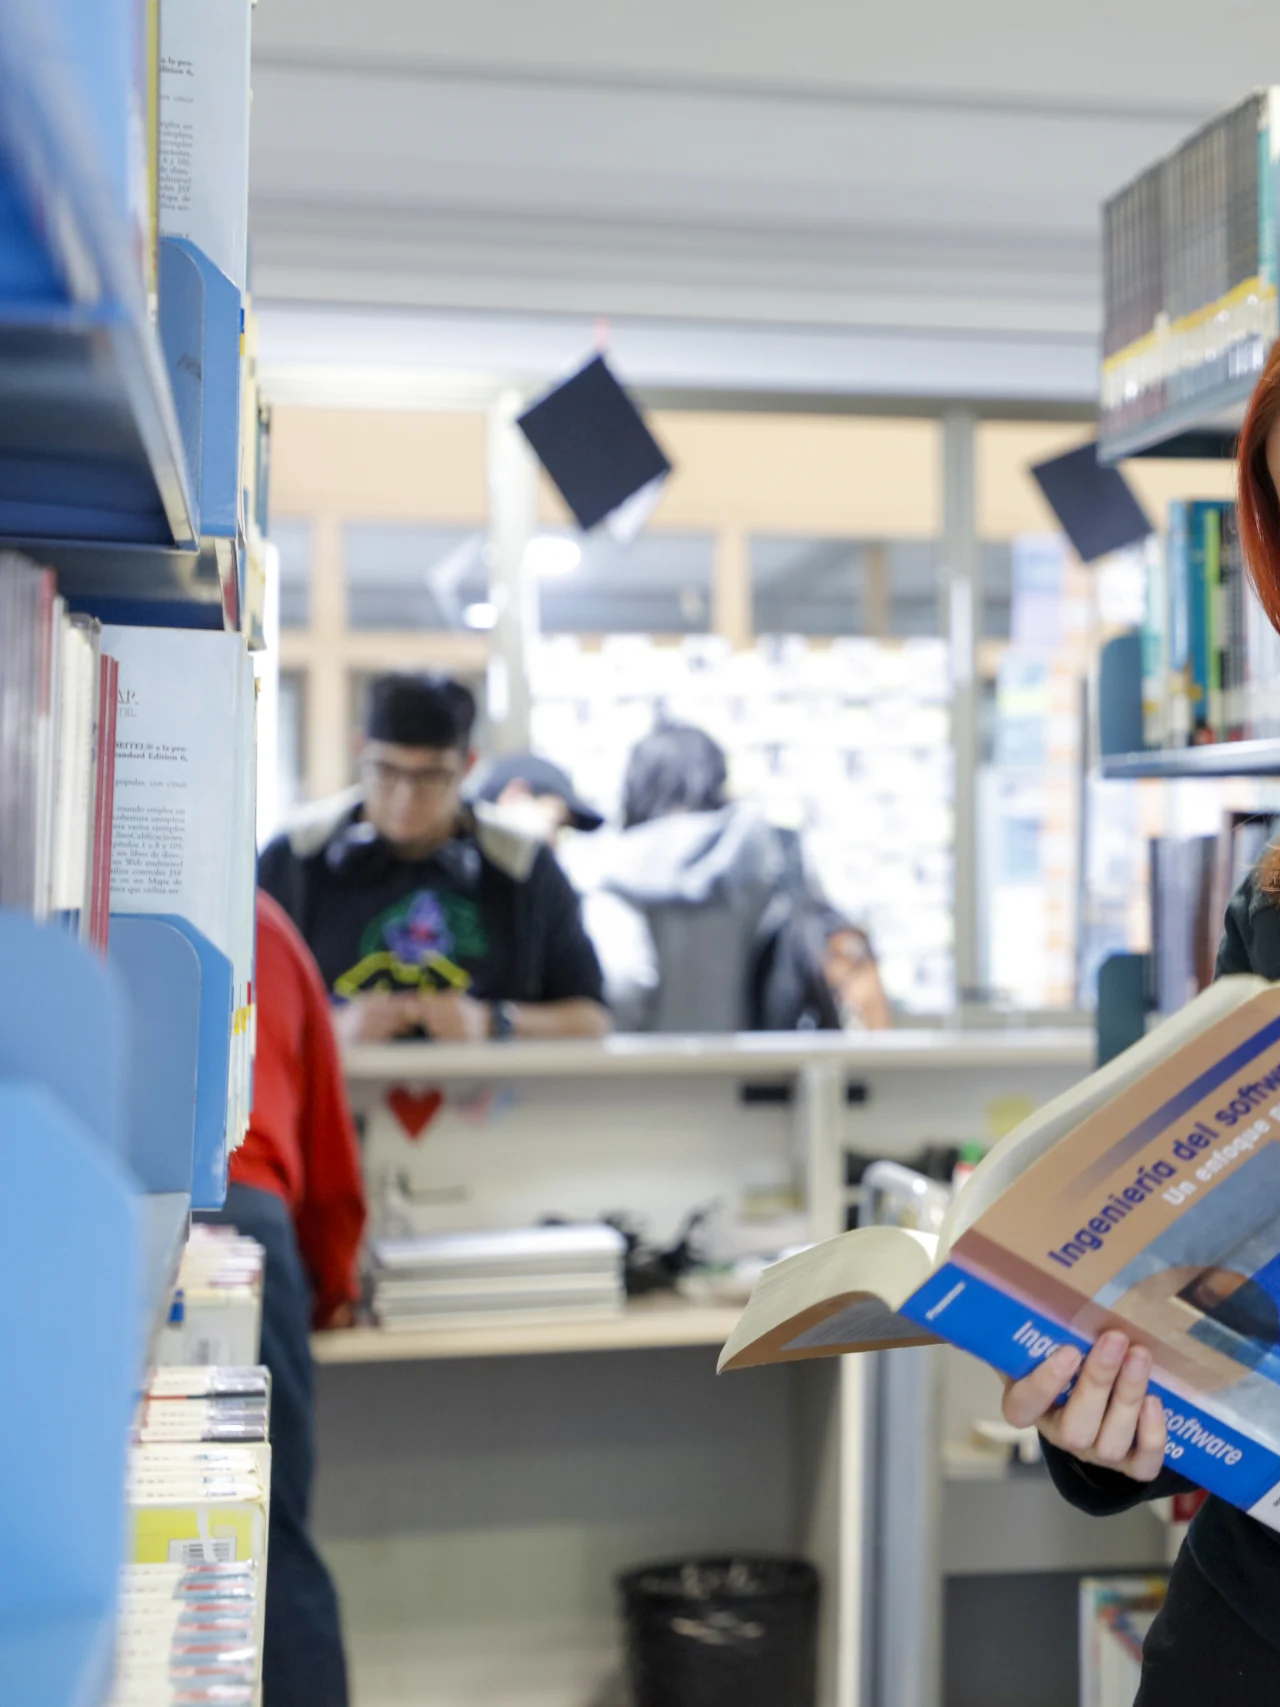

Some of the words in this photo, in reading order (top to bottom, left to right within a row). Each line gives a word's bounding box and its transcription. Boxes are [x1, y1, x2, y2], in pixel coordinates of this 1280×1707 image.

[1047, 1159, 1177, 1269] Ingeniería
[1173, 1121, 1219, 1161] del
[1162, 1180, 1197, 1206] Un
[1195, 1119, 1271, 1182] enfoque
[1163, 1408, 1243, 1466] software
